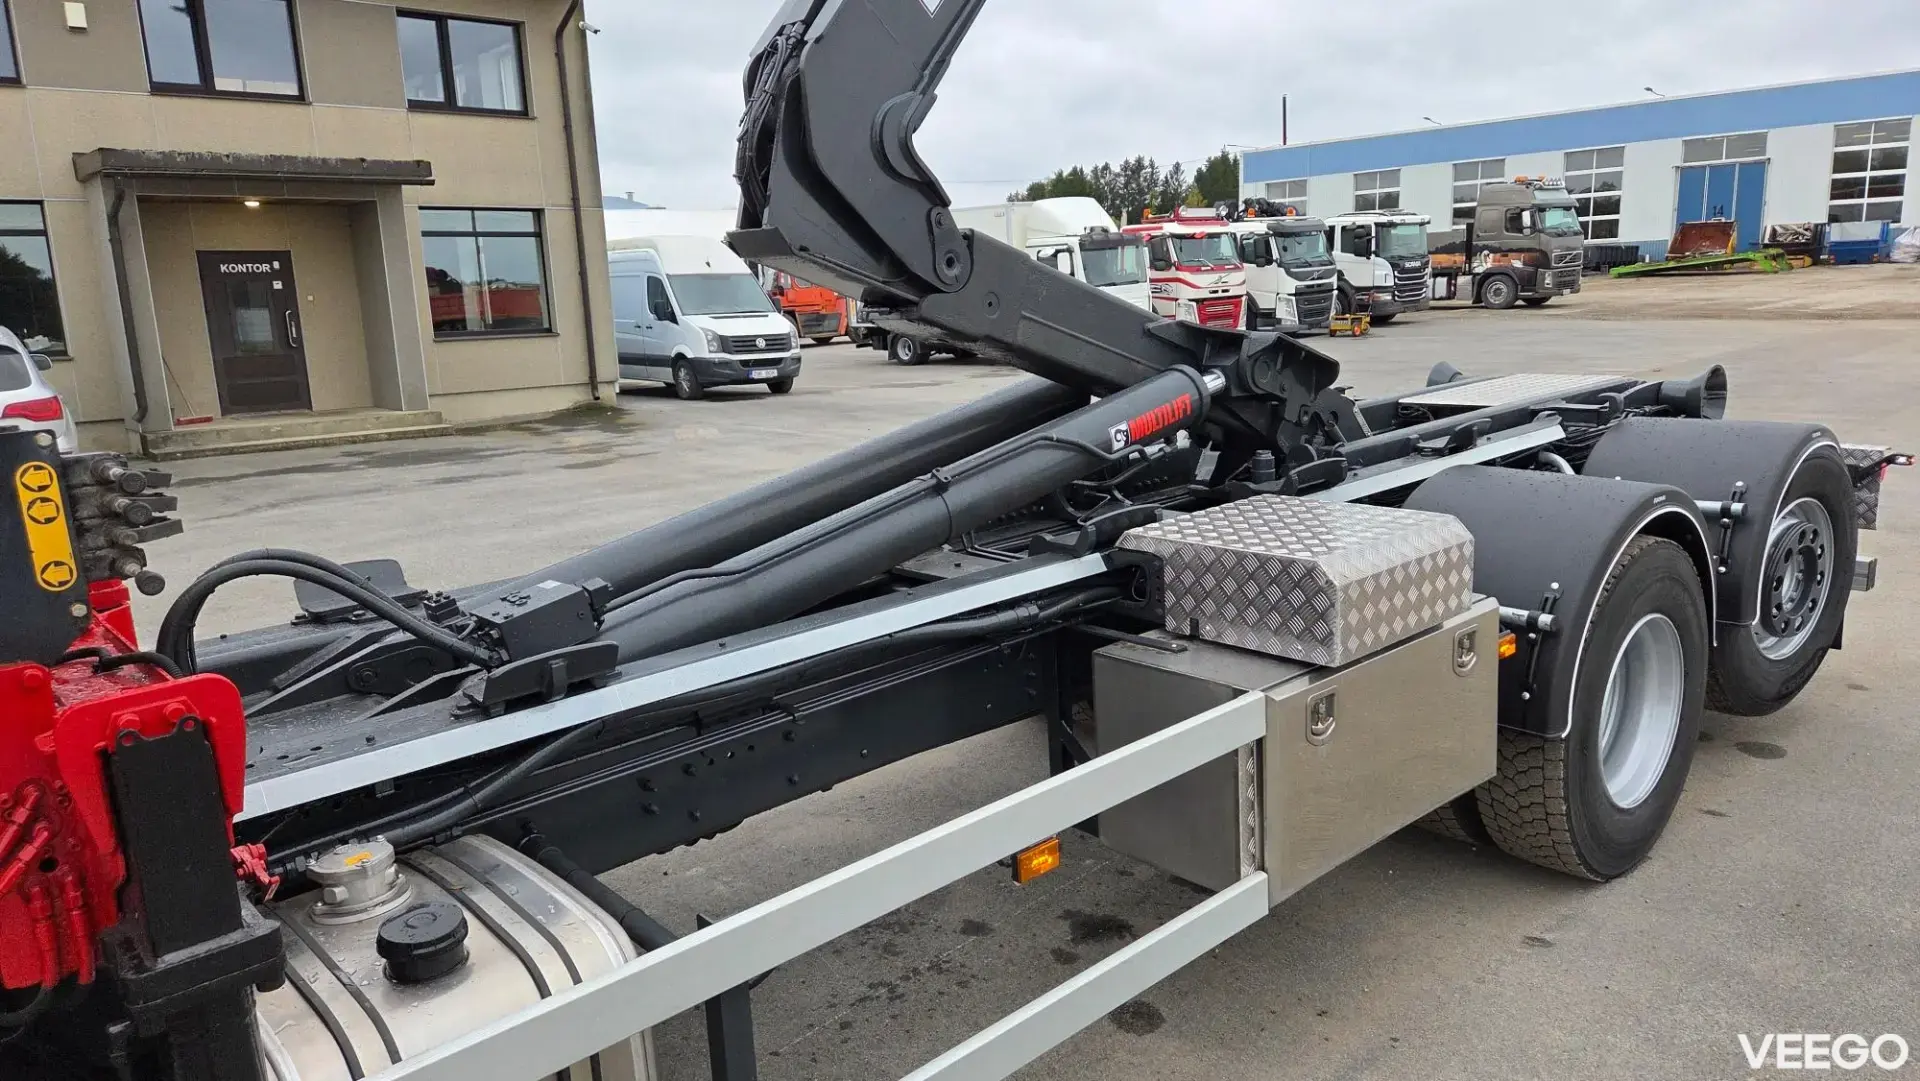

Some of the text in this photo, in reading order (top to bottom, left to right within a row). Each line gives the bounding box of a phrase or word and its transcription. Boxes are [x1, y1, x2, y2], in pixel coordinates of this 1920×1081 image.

[1713, 205, 1724, 216] 14
[220, 263, 271, 273] KONTOR
[1128, 392, 1192, 441] MULTILIFT
